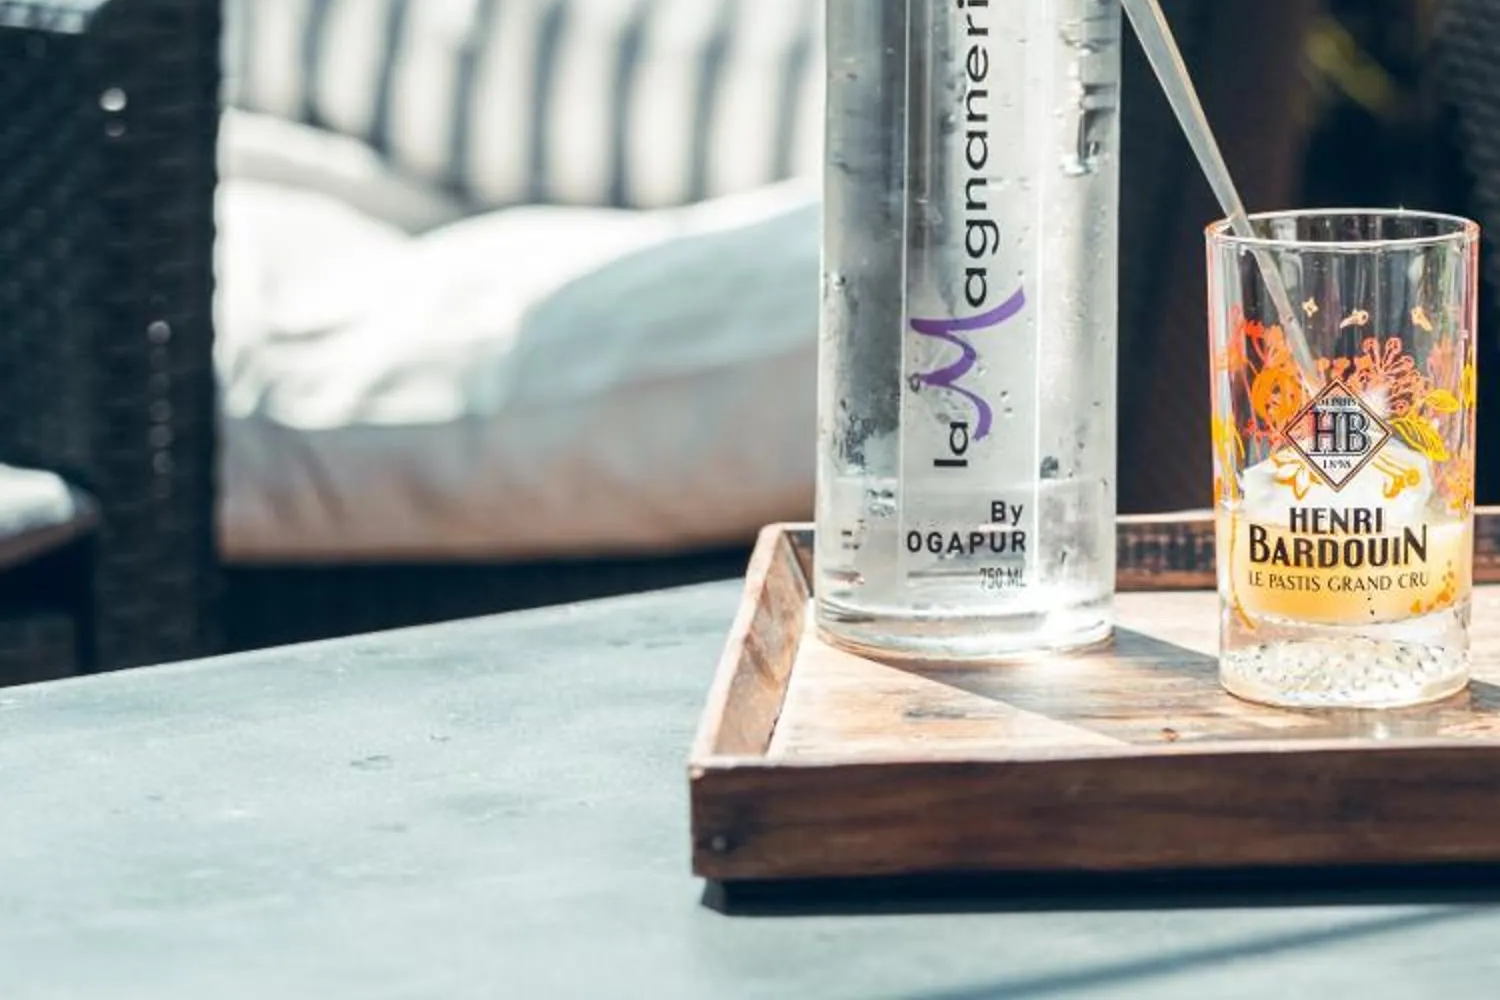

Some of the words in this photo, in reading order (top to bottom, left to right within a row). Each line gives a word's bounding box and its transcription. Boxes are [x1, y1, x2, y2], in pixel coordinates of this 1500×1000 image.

[933, 421, 969, 468] la
[1310, 409, 1371, 453] HB
[991, 501, 1023, 526] By
[1289, 507, 1383, 535] HENRI
[907, 530, 1026, 554] OGAPUR
[1249, 524, 1427, 569] BARDOUIN
[1248, 570, 1263, 587] LE
[1268, 573, 1321, 592] PASTIS
[1327, 574, 1393, 593] GRAND
[1398, 570, 1429, 589] CRU
